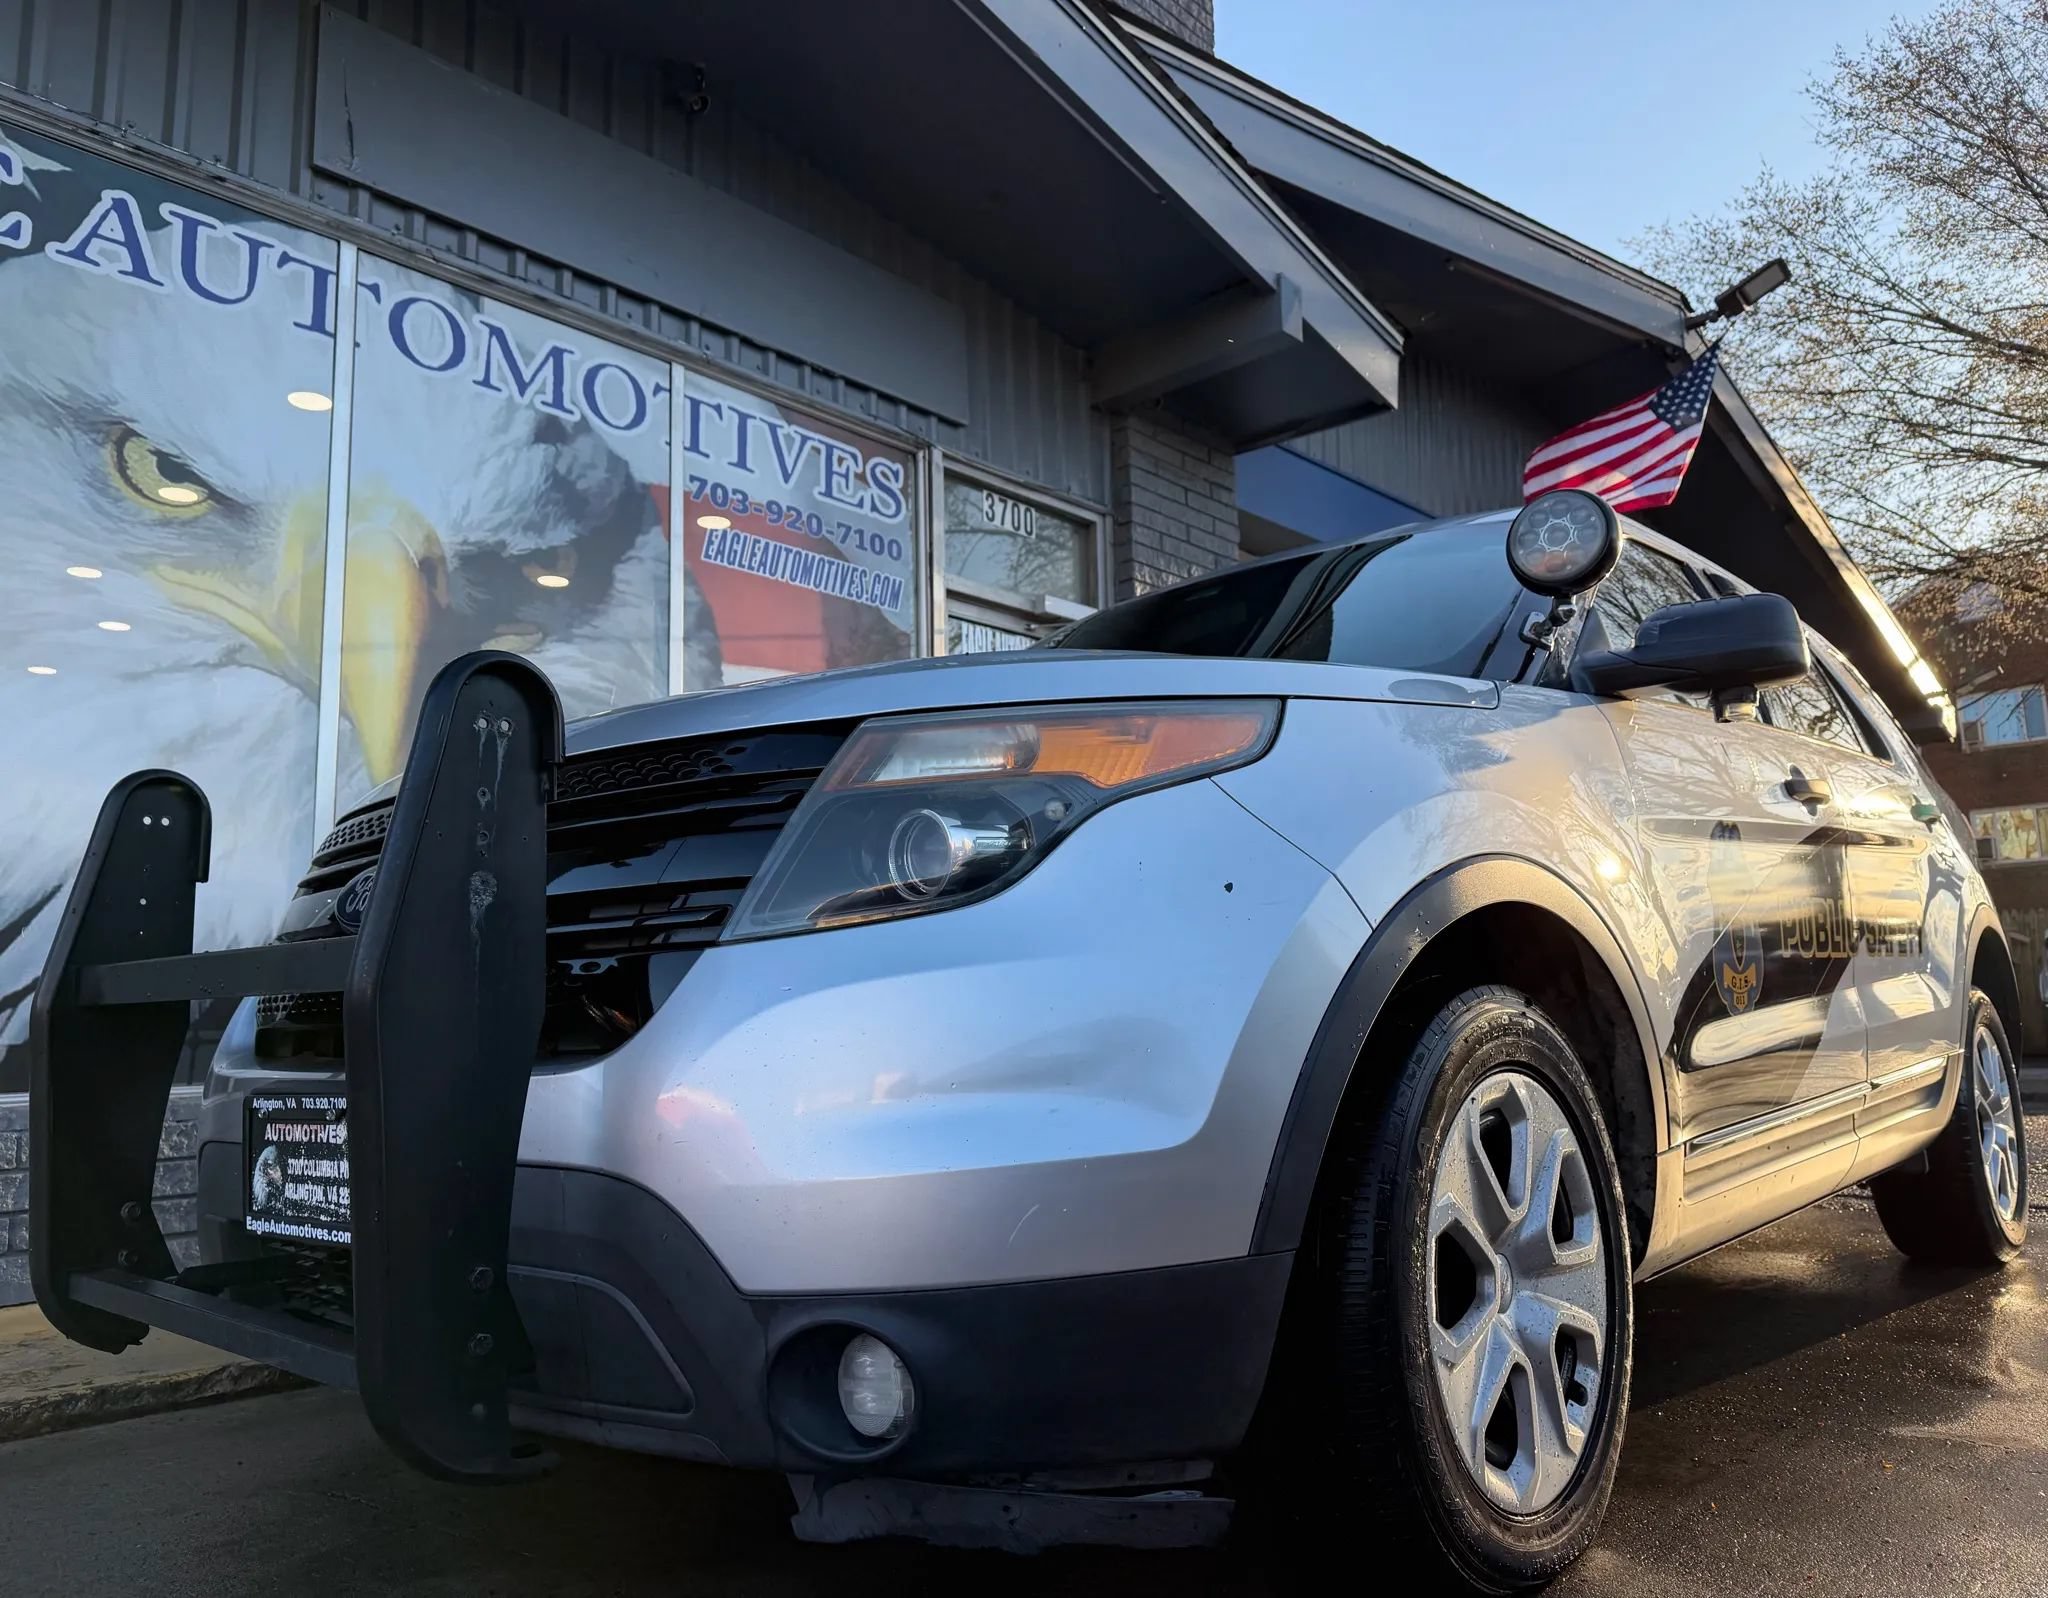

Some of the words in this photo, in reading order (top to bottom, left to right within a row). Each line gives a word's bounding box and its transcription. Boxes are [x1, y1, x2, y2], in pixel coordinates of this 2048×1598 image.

[50, 193, 905, 522] AUTOMOTIVES
[689, 474, 903, 561] 703-920-7100
[985, 492, 1033, 537] 3700
[703, 527, 904, 611] EAGLEAUTOMOTIVES.COM
[252, 1097, 285, 1111] Arlington,
[286, 1098, 297, 1109] VA
[301, 1097, 347, 1110] 703.920.7100
[264, 1123, 346, 1145] AUTOMOTIVES
[327, 1186, 338, 1203] VA
